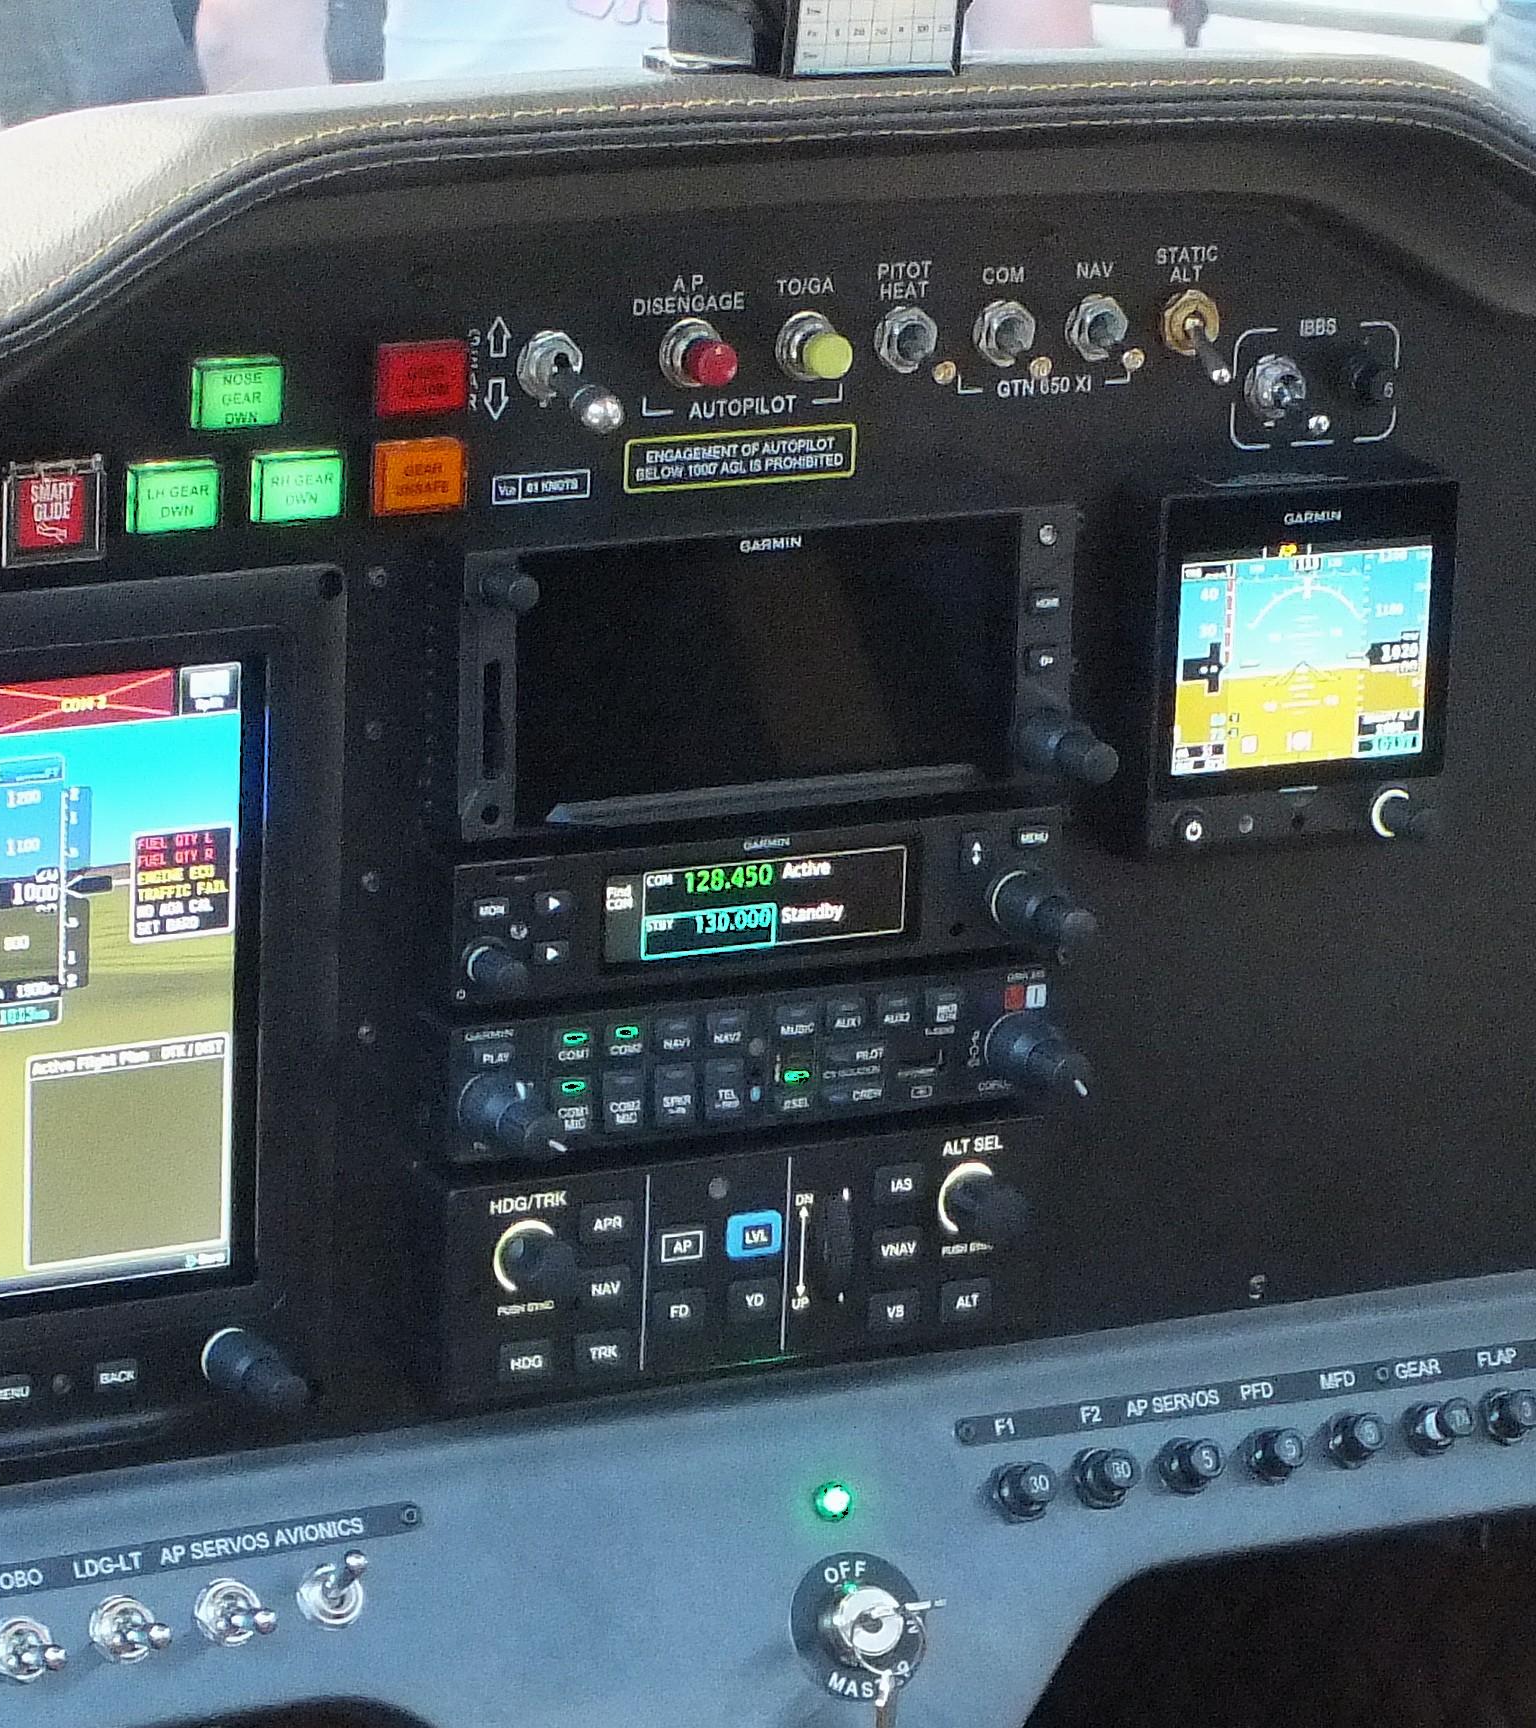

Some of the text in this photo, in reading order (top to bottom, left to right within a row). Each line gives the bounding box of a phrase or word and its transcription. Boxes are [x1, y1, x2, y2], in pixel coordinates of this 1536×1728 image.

[1157, 245, 1218, 265] STATIC
[878, 262, 932, 281] PITOT
[982, 266, 1025, 285] COM
[1076, 262, 1115, 280] NAV
[1169, 264, 1203, 283] ALT
[777, 277, 835, 296] TO/GA
[879, 281, 928, 300] HEAT
[632, 291, 745, 316] DISENGAGE
[222, 371, 263, 386] NOSE
[997, 379, 1034, 398] GTN
[222, 391, 262, 406] GEAR
[688, 395, 797, 420] AUTOPILOT
[224, 411, 258, 425] DWN
[646, 435, 836, 464] ENGAGEMENT OF AUTOPILOT
[635, 463, 683, 482] BELOW
[765, 452, 844, 472] PROHIBITED
[289, 472, 334, 486] GEAR
[30, 481, 75, 503] SMART
[170, 484, 209, 498] GEAR
[285, 493, 318, 505] DWN
[160, 505, 194, 519] DWN
[1284, 510, 1342, 526] GARMIN
[739, 535, 803, 554] GARMIN
[136, 831, 214, 850] FUEL QTY L
[136, 847, 214, 868] FUEL QTY R
[646, 860, 832, 893] COM 128.450 Active
[694, 901, 845, 935] 130.000 Standby
[834, 1015, 861, 1029] AUX1
[482, 1051, 510, 1064] PLAY
[558, 1048, 590, 1062] COM1
[942, 1134, 1004, 1157] ALT SEL
[890, 1177, 913, 1193] IAS
[489, 1190, 568, 1215] HDG/TRK
[795, 1192, 814, 1206] DN
[593, 1215, 623, 1232] APR
[744, 1228, 768, 1244] LVL
[672, 1239, 693, 1254] AP
[880, 1240, 917, 1257] VNAV
[591, 1280, 621, 1297] NAV
[745, 1292, 765, 1308] YD
[791, 1296, 810, 1311] UP
[955, 1292, 980, 1310] ALT
[669, 1303, 689, 1319] FD
[590, 1343, 618, 1360] TRK
[1476, 1347, 1517, 1369] FLAP
[510, 1355, 543, 1371] HDG
[1394, 1357, 1442, 1380] GEAR
[99, 1368, 137, 1386] BACK
[1319, 1369, 1356, 1391] MFD
[1240, 1381, 1274, 1401] PFD
[1126, 1389, 1220, 1418] AP SERVOS
[1079, 1405, 1102, 1424] F2
[994, 1417, 1015, 1436] F1
[1201, 1449, 1214, 1468] 5
[1112, 1461, 1133, 1479] 30
[1028, 1473, 1050, 1494] 30
[274, 1516, 364, 1548] AVIONICS
[159, 1530, 269, 1567] AP SERVOS
[72, 1550, 143, 1579] LDG-LT
[824, 1560, 867, 1583] OFF
